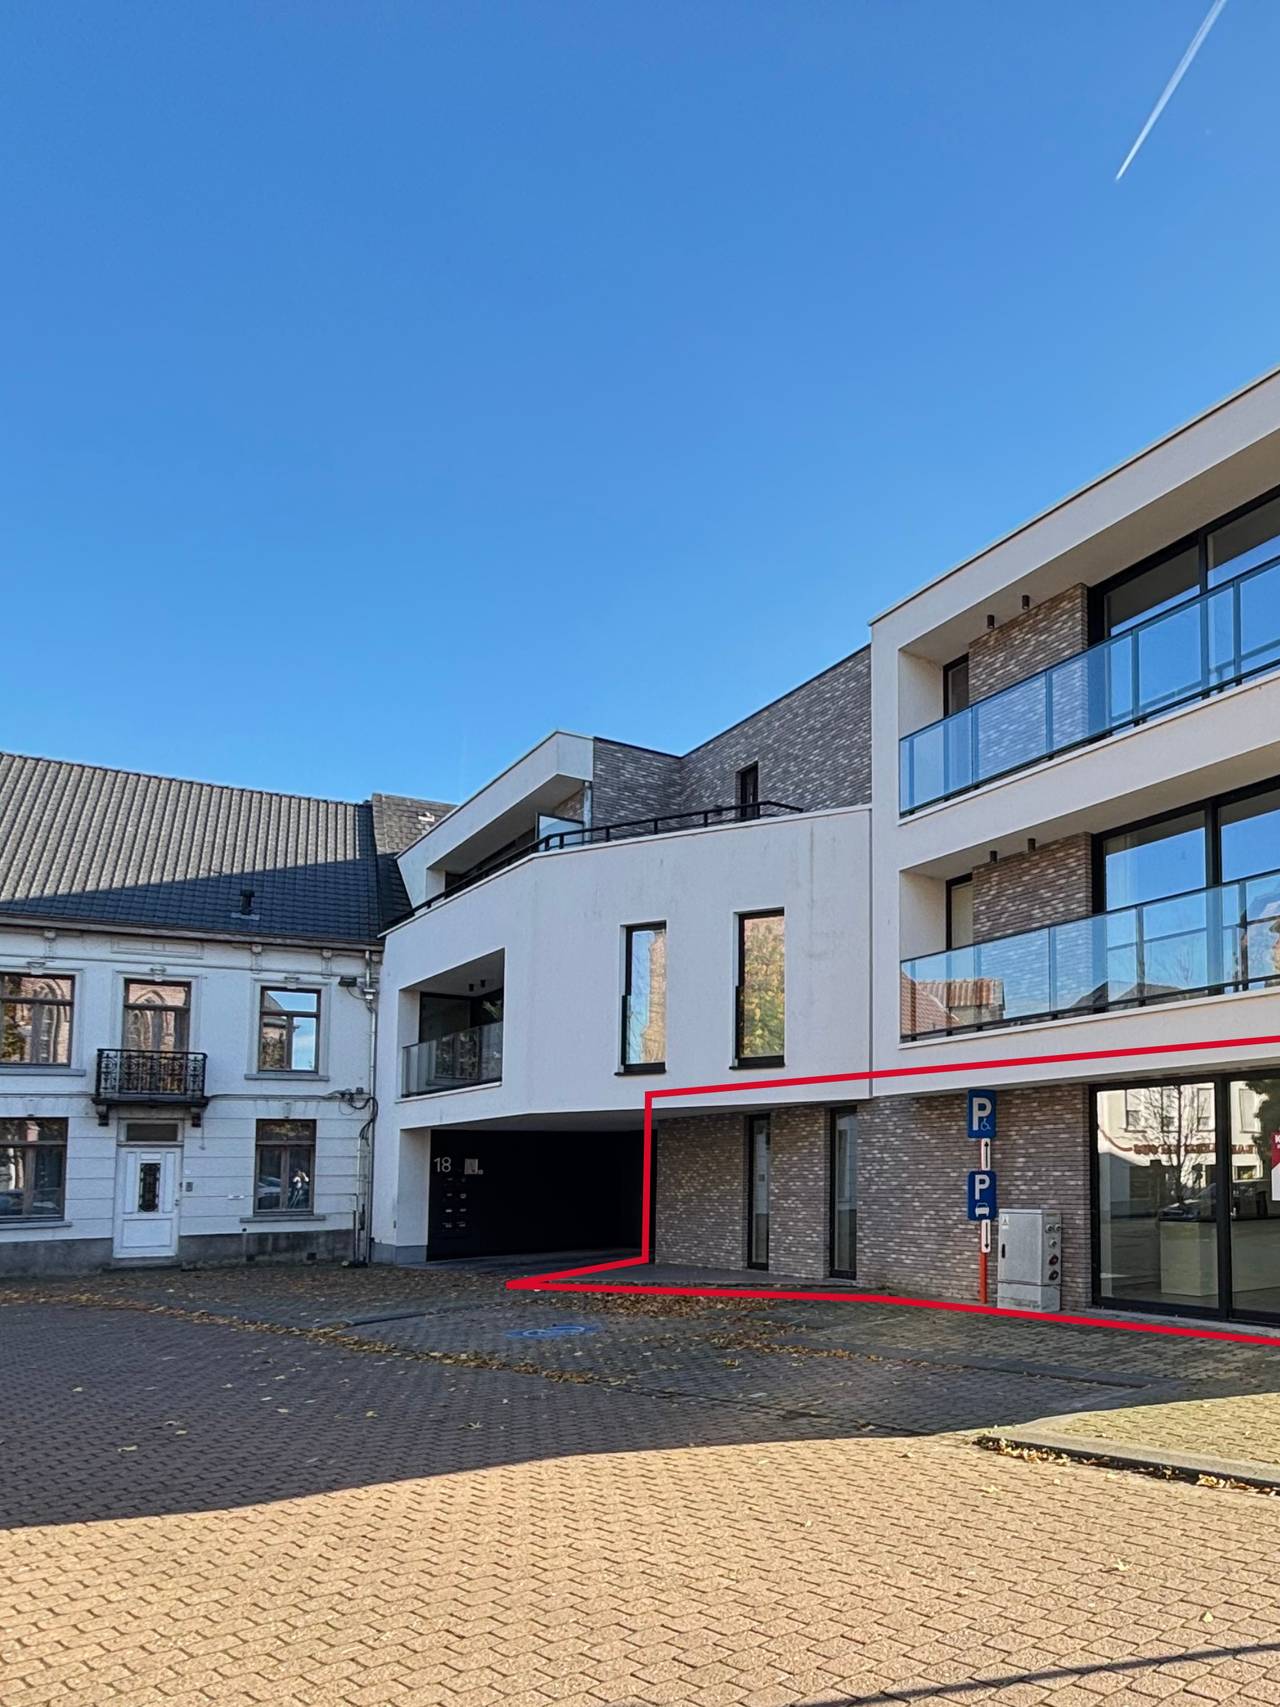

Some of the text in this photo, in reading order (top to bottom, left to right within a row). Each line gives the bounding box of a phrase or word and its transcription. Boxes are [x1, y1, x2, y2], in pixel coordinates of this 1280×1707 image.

[972, 1097, 992, 1131] P
[433, 1156, 452, 1173] 18
[975, 1174, 991, 1200] P
